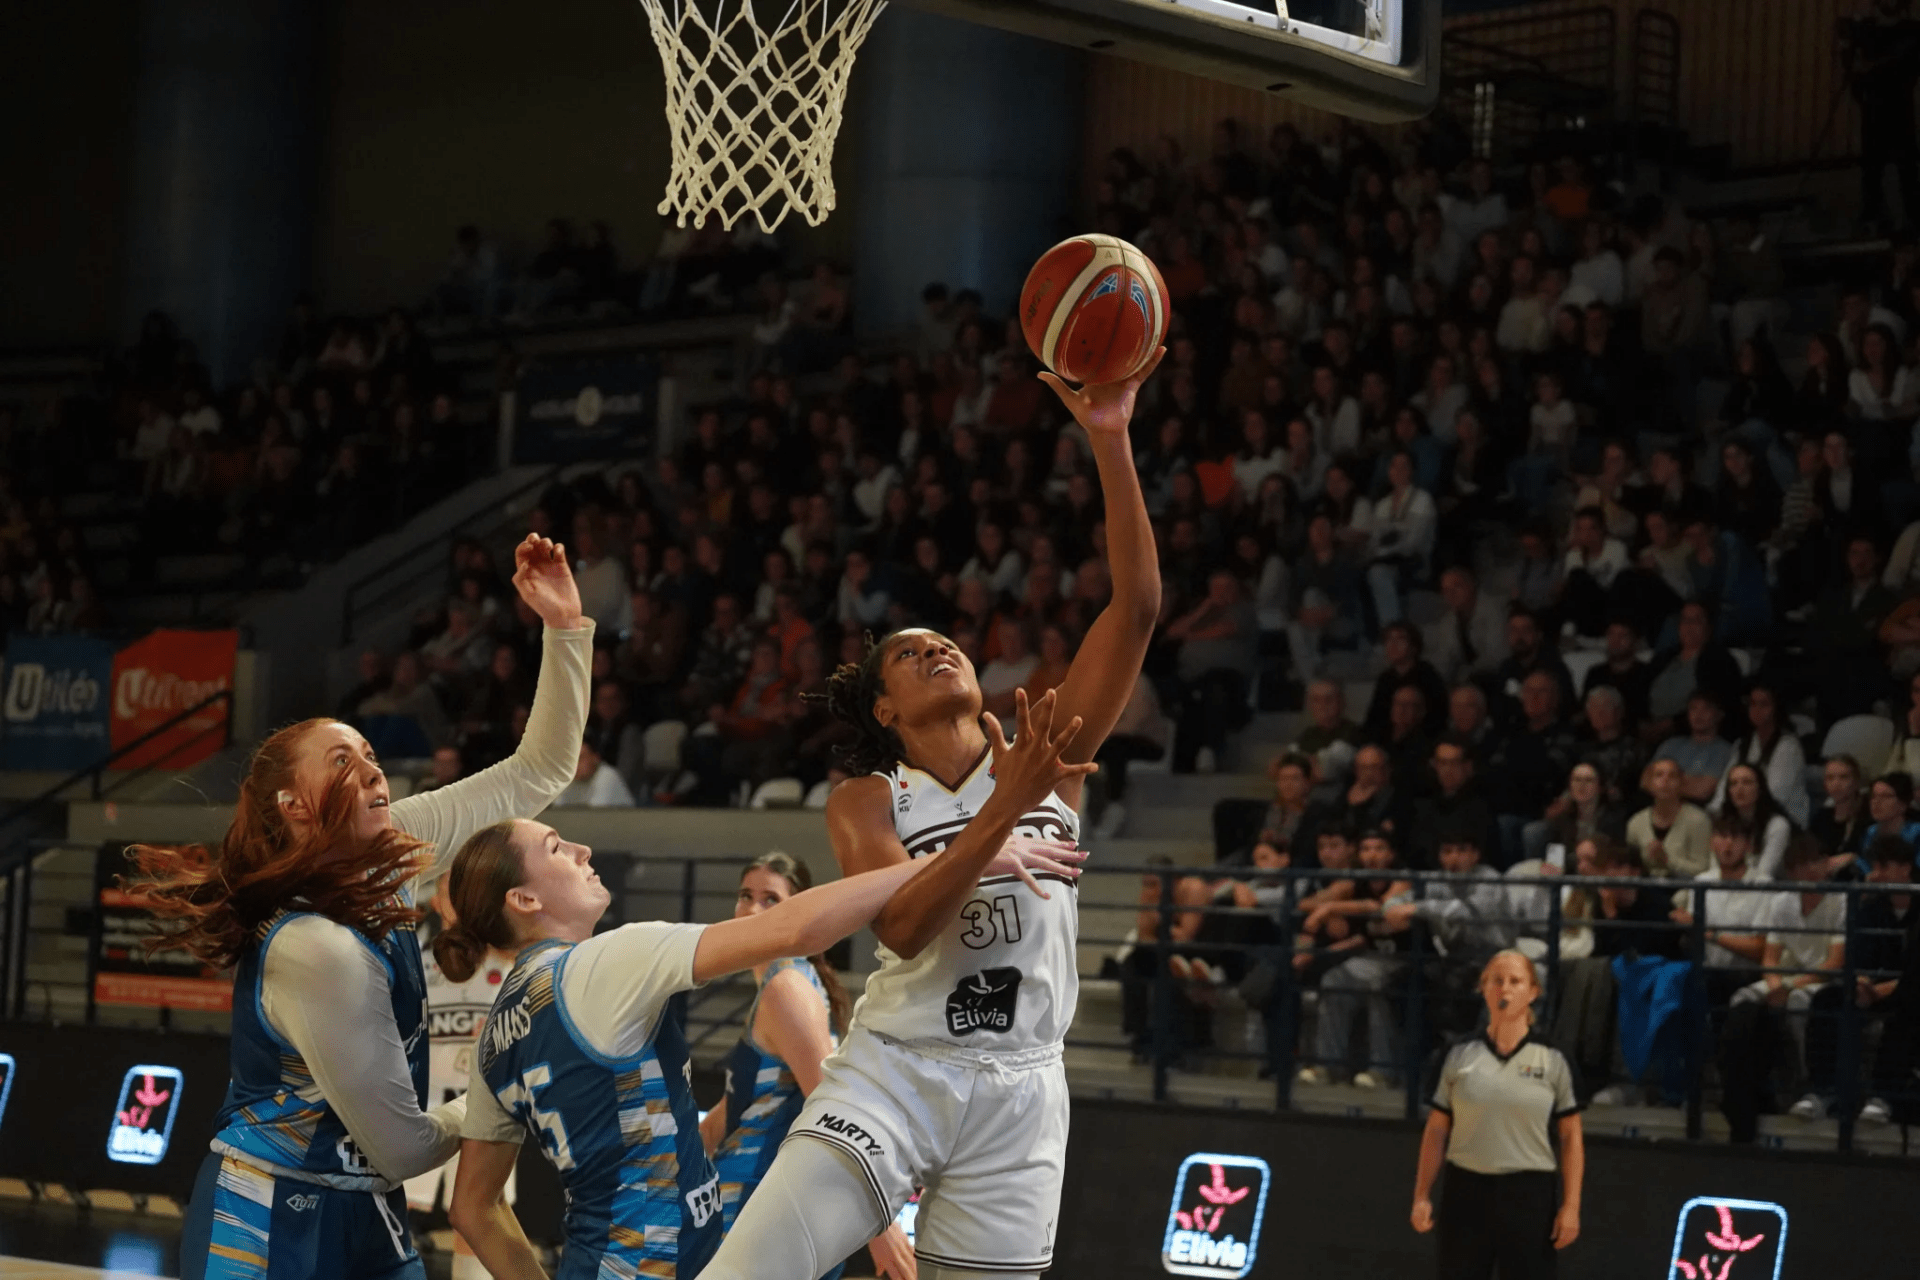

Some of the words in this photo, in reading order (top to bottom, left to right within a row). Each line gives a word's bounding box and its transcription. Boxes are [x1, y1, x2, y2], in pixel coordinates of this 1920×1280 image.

[960, 894, 1022, 950] 31
[951, 1008, 1009, 1031] Elivia
[816, 1113, 881, 1151] MARTY
[1169, 1229, 1248, 1268] Elivia
